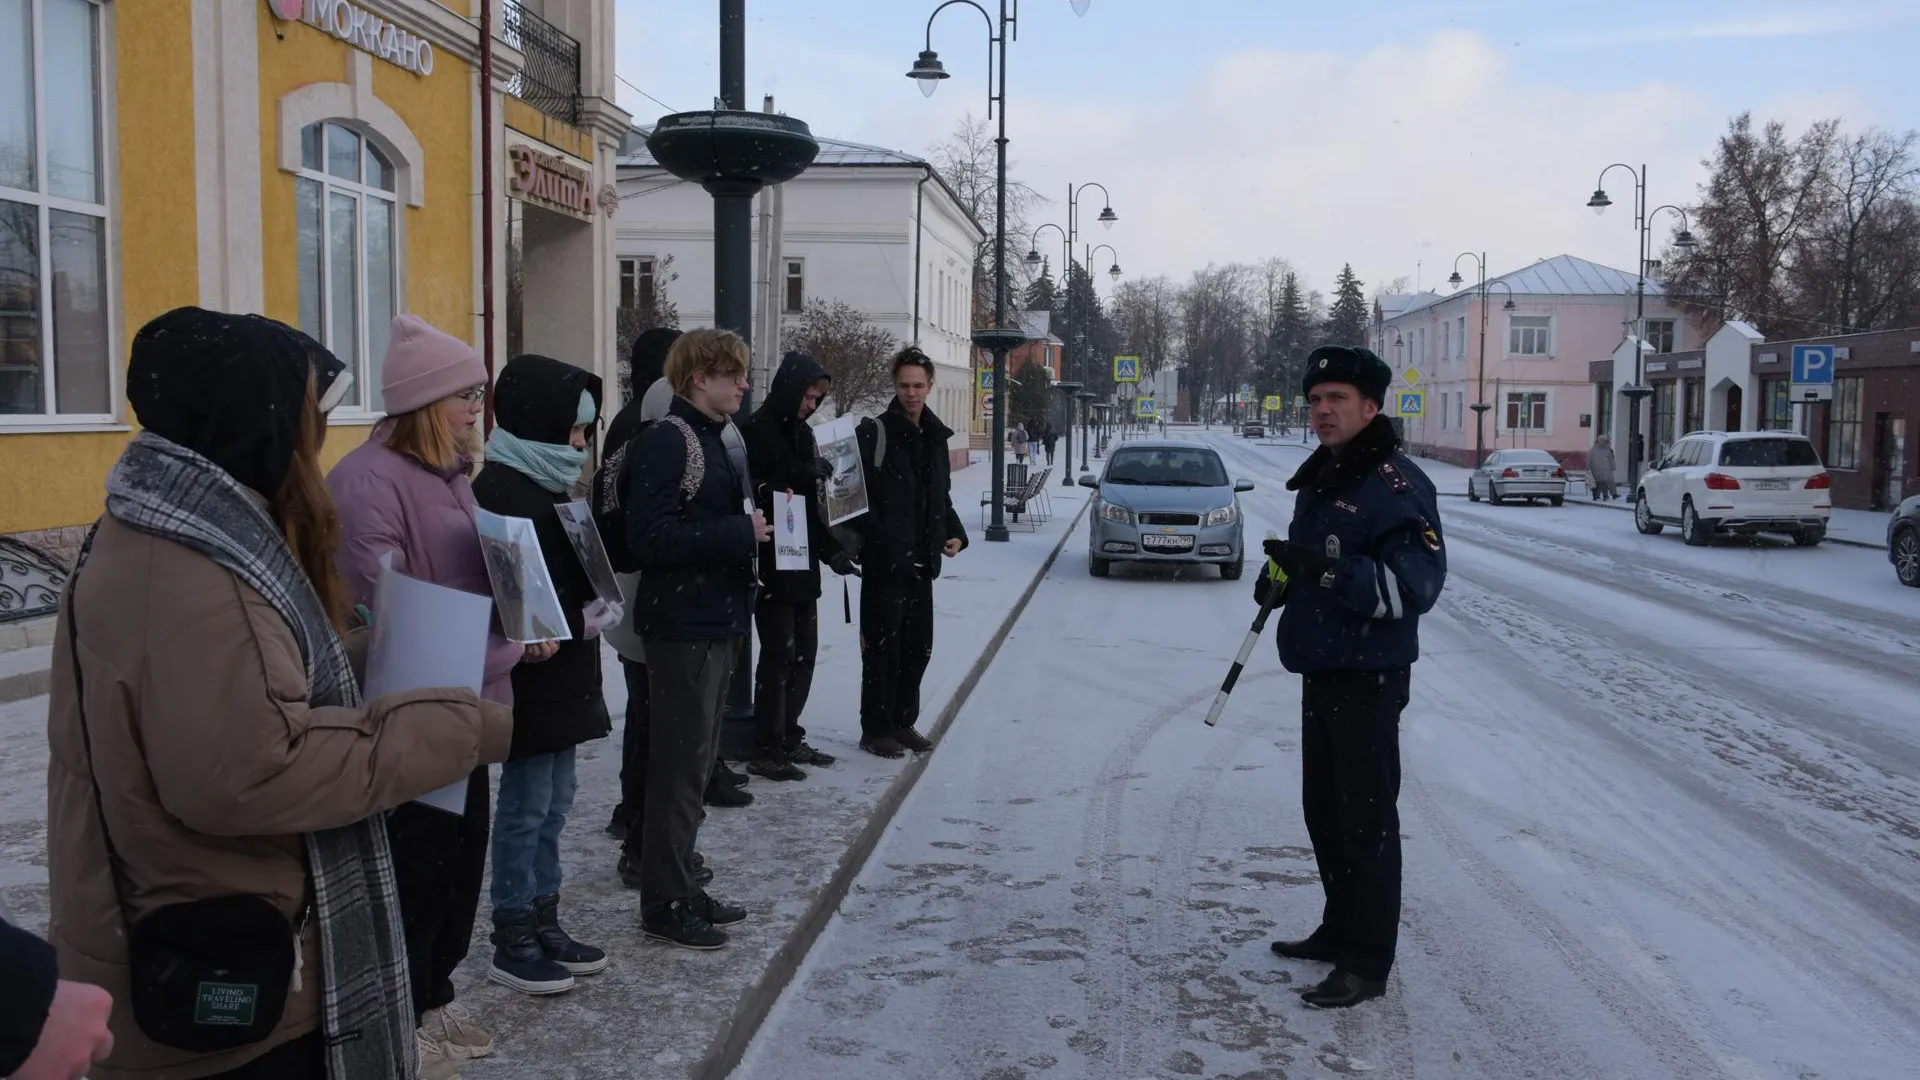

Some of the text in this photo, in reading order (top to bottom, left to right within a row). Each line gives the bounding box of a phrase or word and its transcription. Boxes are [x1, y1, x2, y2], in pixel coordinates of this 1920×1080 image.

[305, 0, 433, 76] МОККАНО
[1802, 350, 1826, 379] P
[211, 1002, 241, 1011] SHARE
